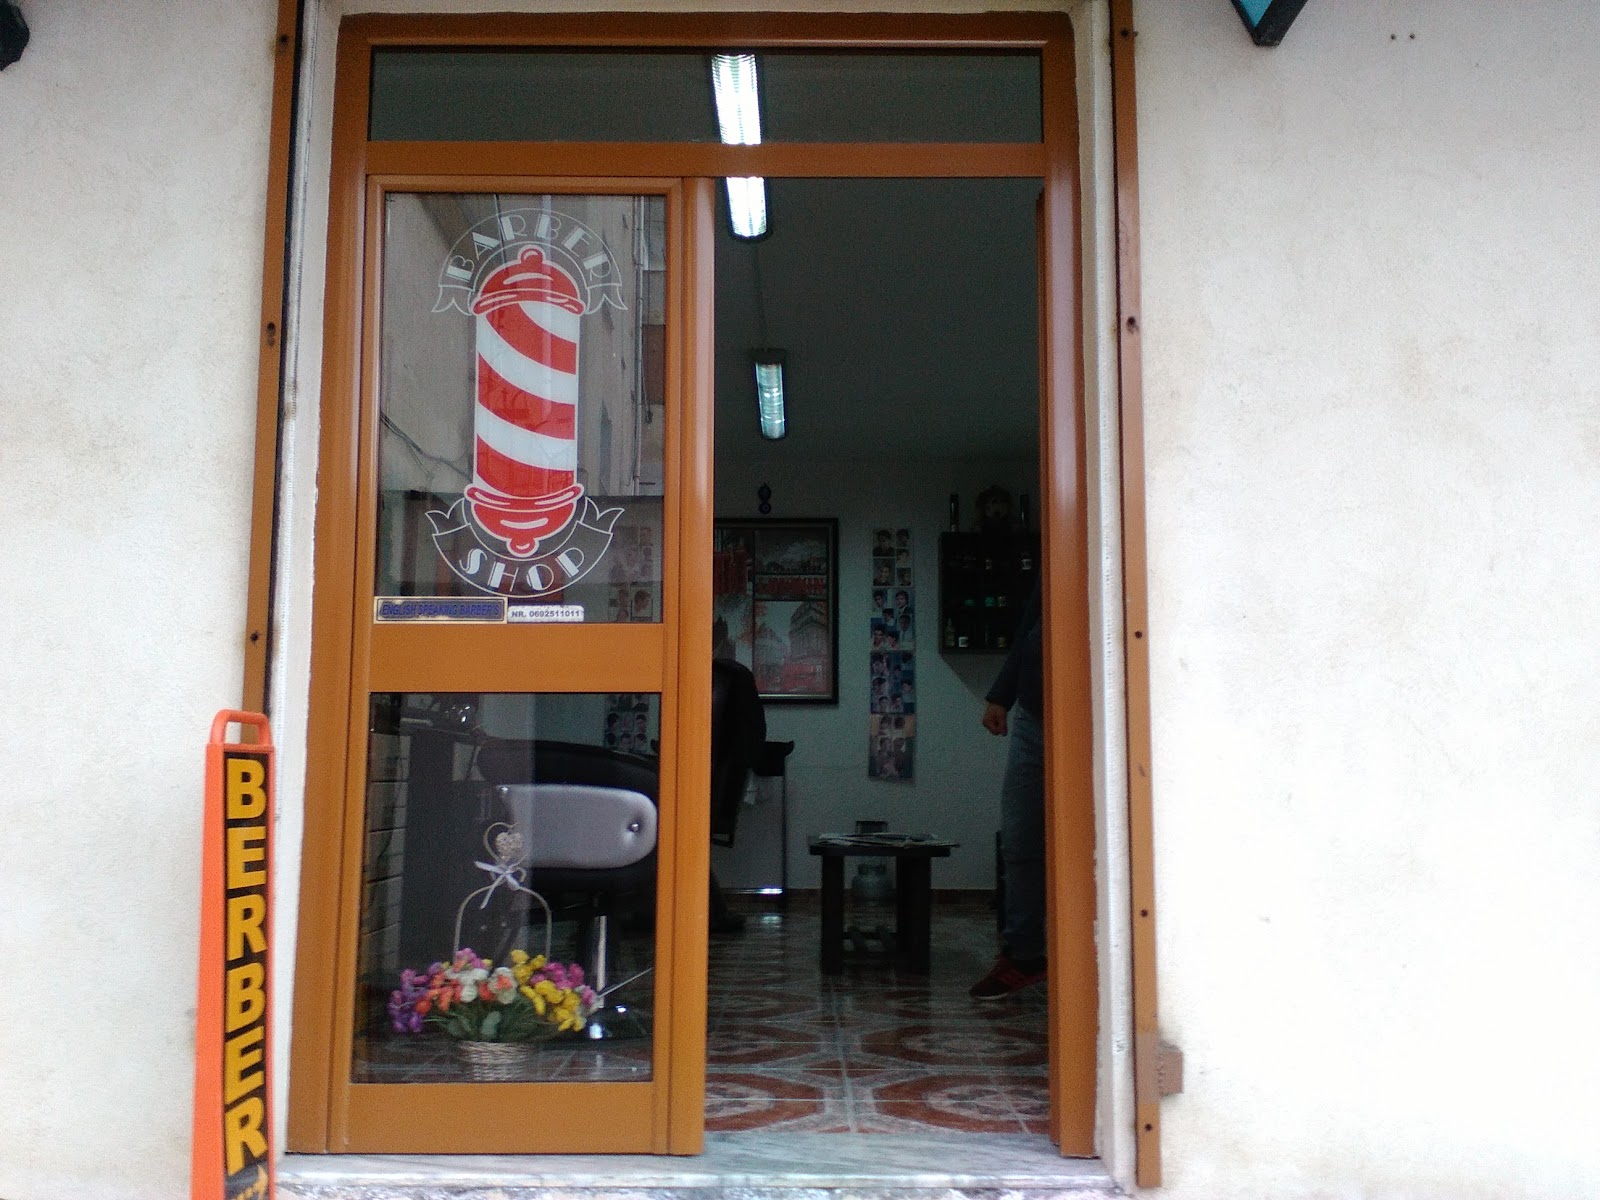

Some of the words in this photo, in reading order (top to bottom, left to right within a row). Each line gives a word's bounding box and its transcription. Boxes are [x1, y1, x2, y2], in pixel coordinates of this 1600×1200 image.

[446, 213, 612, 283] BARBER
[459, 547, 585, 592] SHOP
[381, 604, 417, 616] ENGLISH
[418, 604, 457, 616] SPEAKING
[511, 610, 527, 618] NR.
[225, 758, 267, 1176] BERBER
